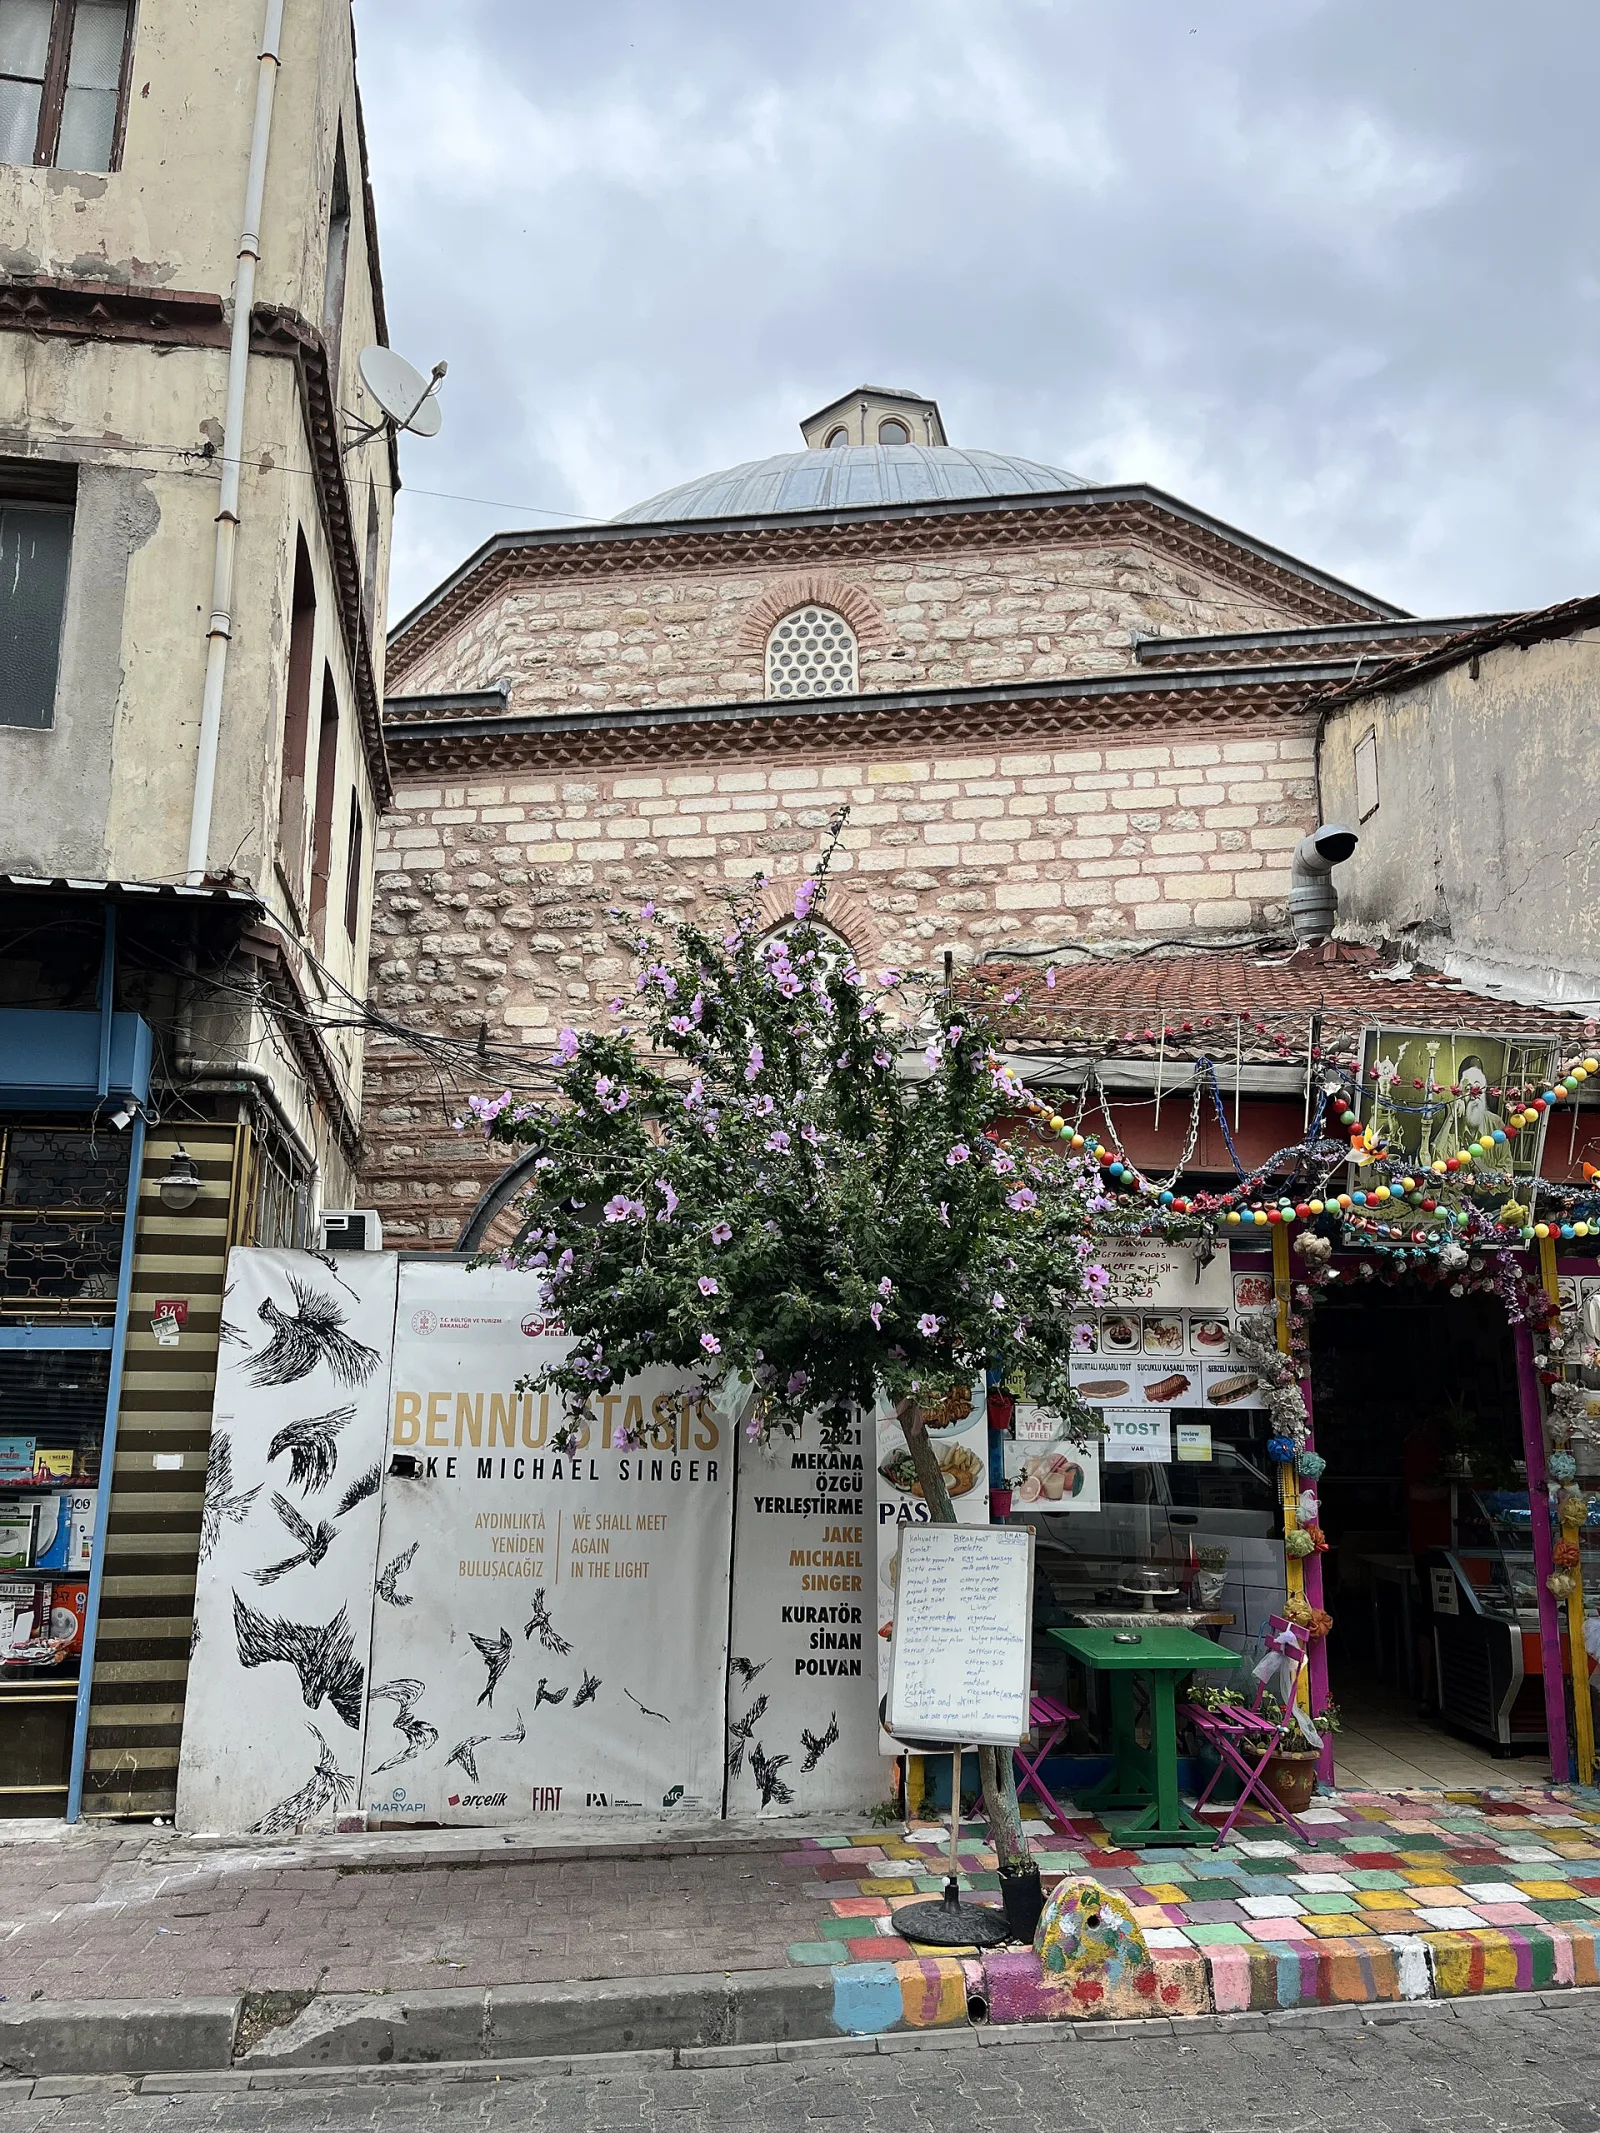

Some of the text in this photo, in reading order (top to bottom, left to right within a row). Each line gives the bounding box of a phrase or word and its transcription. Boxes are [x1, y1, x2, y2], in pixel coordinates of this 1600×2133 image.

[1113, 1263, 1135, 1271] CAFE
[1098, 1363, 1119, 1373] KAŞARLI
[1119, 1363, 1131, 1371] TOST
[1162, 1364, 1184, 1373] KAŞARLI
[1186, 1364, 1199, 1372] TOST
[1228, 1365, 1248, 1375] KAŞARLI
[393, 1391, 549, 1449] BENNU
[1113, 1422, 1161, 1436] TOST
[1027, 1431, 1051, 1439] (FREE)
[477, 1457, 600, 1480] MICHAEL
[619, 1459, 719, 1482] SINGER
[791, 1453, 864, 1471] MEKANA
[815, 1472, 864, 1493] ÖZGÜ
[754, 1493, 863, 1519] YERLEŞTİRME
[878, 1502, 928, 1524] PAS
[474, 1513, 546, 1531] AYDINLIKTA
[573, 1514, 668, 1531] WE SHALL MEET
[491, 1533, 544, 1554] YENİDEN
[821, 1526, 863, 1544] JAKE
[953, 1534, 991, 1544] Breakfast
[571, 1537, 609, 1554] AGAIN
[789, 1550, 863, 1568] MICHAEL
[458, 1556, 544, 1581] BULUŞACAĞIZ
[570, 1561, 650, 1579] IN THE LIGHT
[801, 1574, 863, 1592] SINGER
[782, 1602, 863, 1624] KURATÖR
[809, 1627, 862, 1650] SİNAN
[794, 1658, 862, 1677] POLVAN
[937, 1694, 952, 1707] and
[957, 1695, 982, 1707] drink
[942, 1713, 959, 1723] open
[961, 1710, 978, 1719] until
[461, 1791, 510, 1810] arçelik
[532, 1786, 563, 1812] FIAT
[664, 1791, 683, 1801] MG
[371, 1802, 426, 1812] MARYAPI
